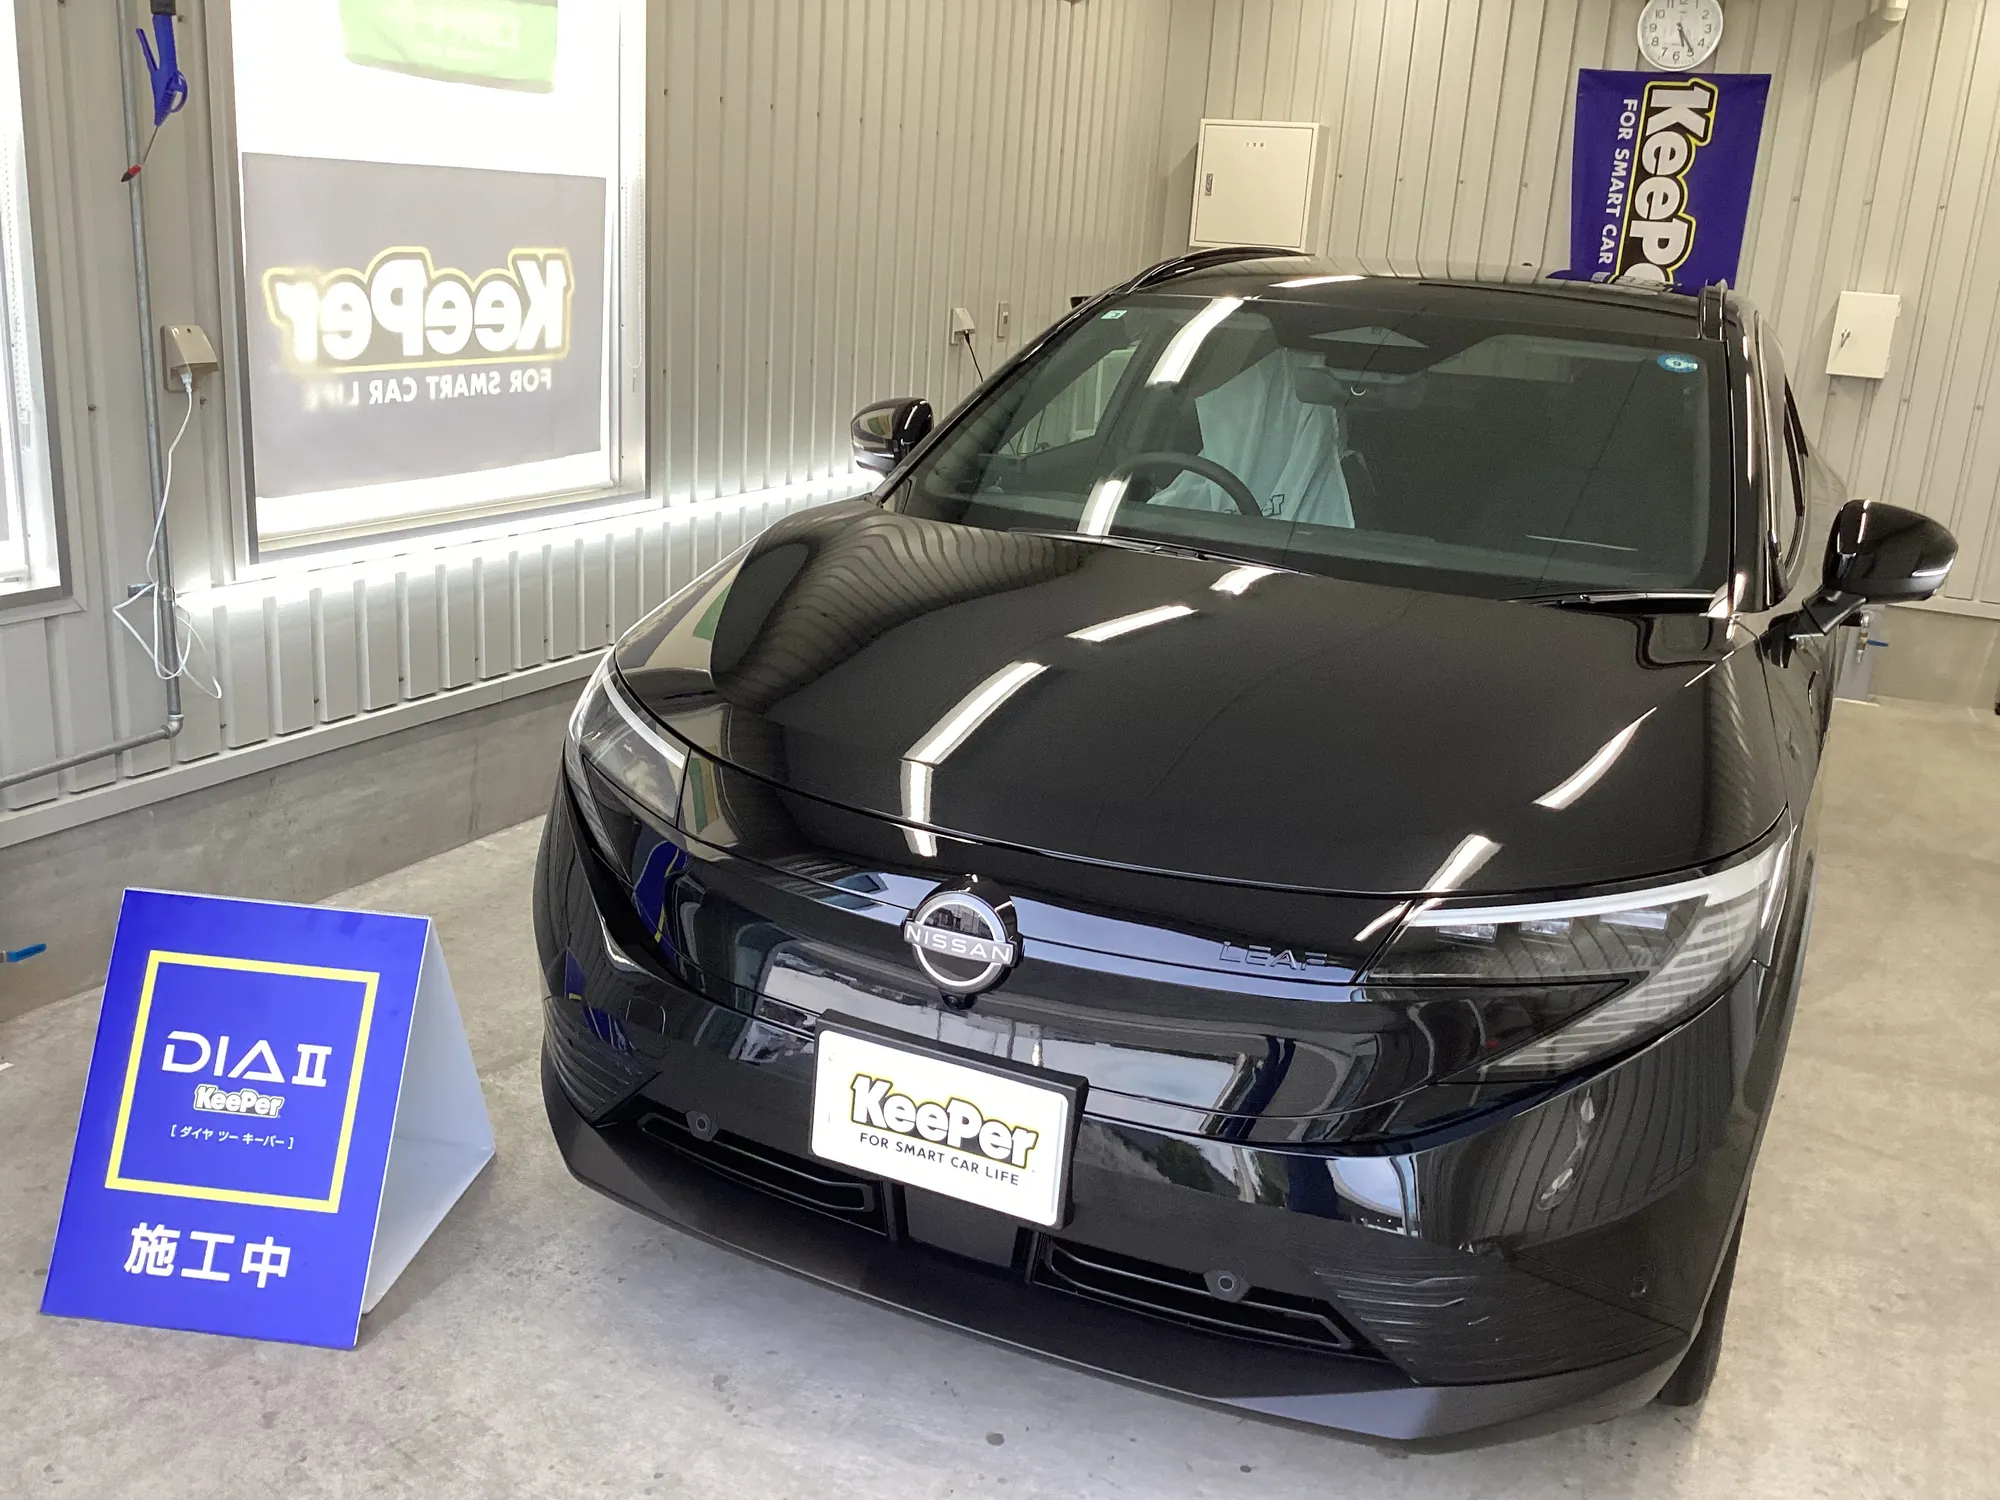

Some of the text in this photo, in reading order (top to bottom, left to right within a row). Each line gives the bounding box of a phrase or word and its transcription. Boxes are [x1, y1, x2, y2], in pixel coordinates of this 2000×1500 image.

[1649, 23, 1657, 32] 9
[1655, 9, 1665, 19] 10
[1701, 10, 1710, 19] 2
[1704, 24, 1712, 34] 3
[1651, 36, 1659, 46] 8
[1661, 47, 1668, 57] 7
[1672, 51, 1680, 61] 6
[1697, 38, 1705, 47] 4
[1617, 99, 1638, 140] FOR
[1605, 148, 1630, 218] SMART
[1598, 223, 1618, 264] CAR
[906, 924, 1010, 962] NISSAN
[1219, 941, 1328, 971] LEAF
[162, 1030, 286, 1083] DIA
[194, 1084, 285, 1118] KeePer
[850, 1073, 1040, 1170] KeePer
[859, 1132, 1019, 1186] FOR SMART CAR LIFE
[123, 1221, 291, 1289] 施工中
